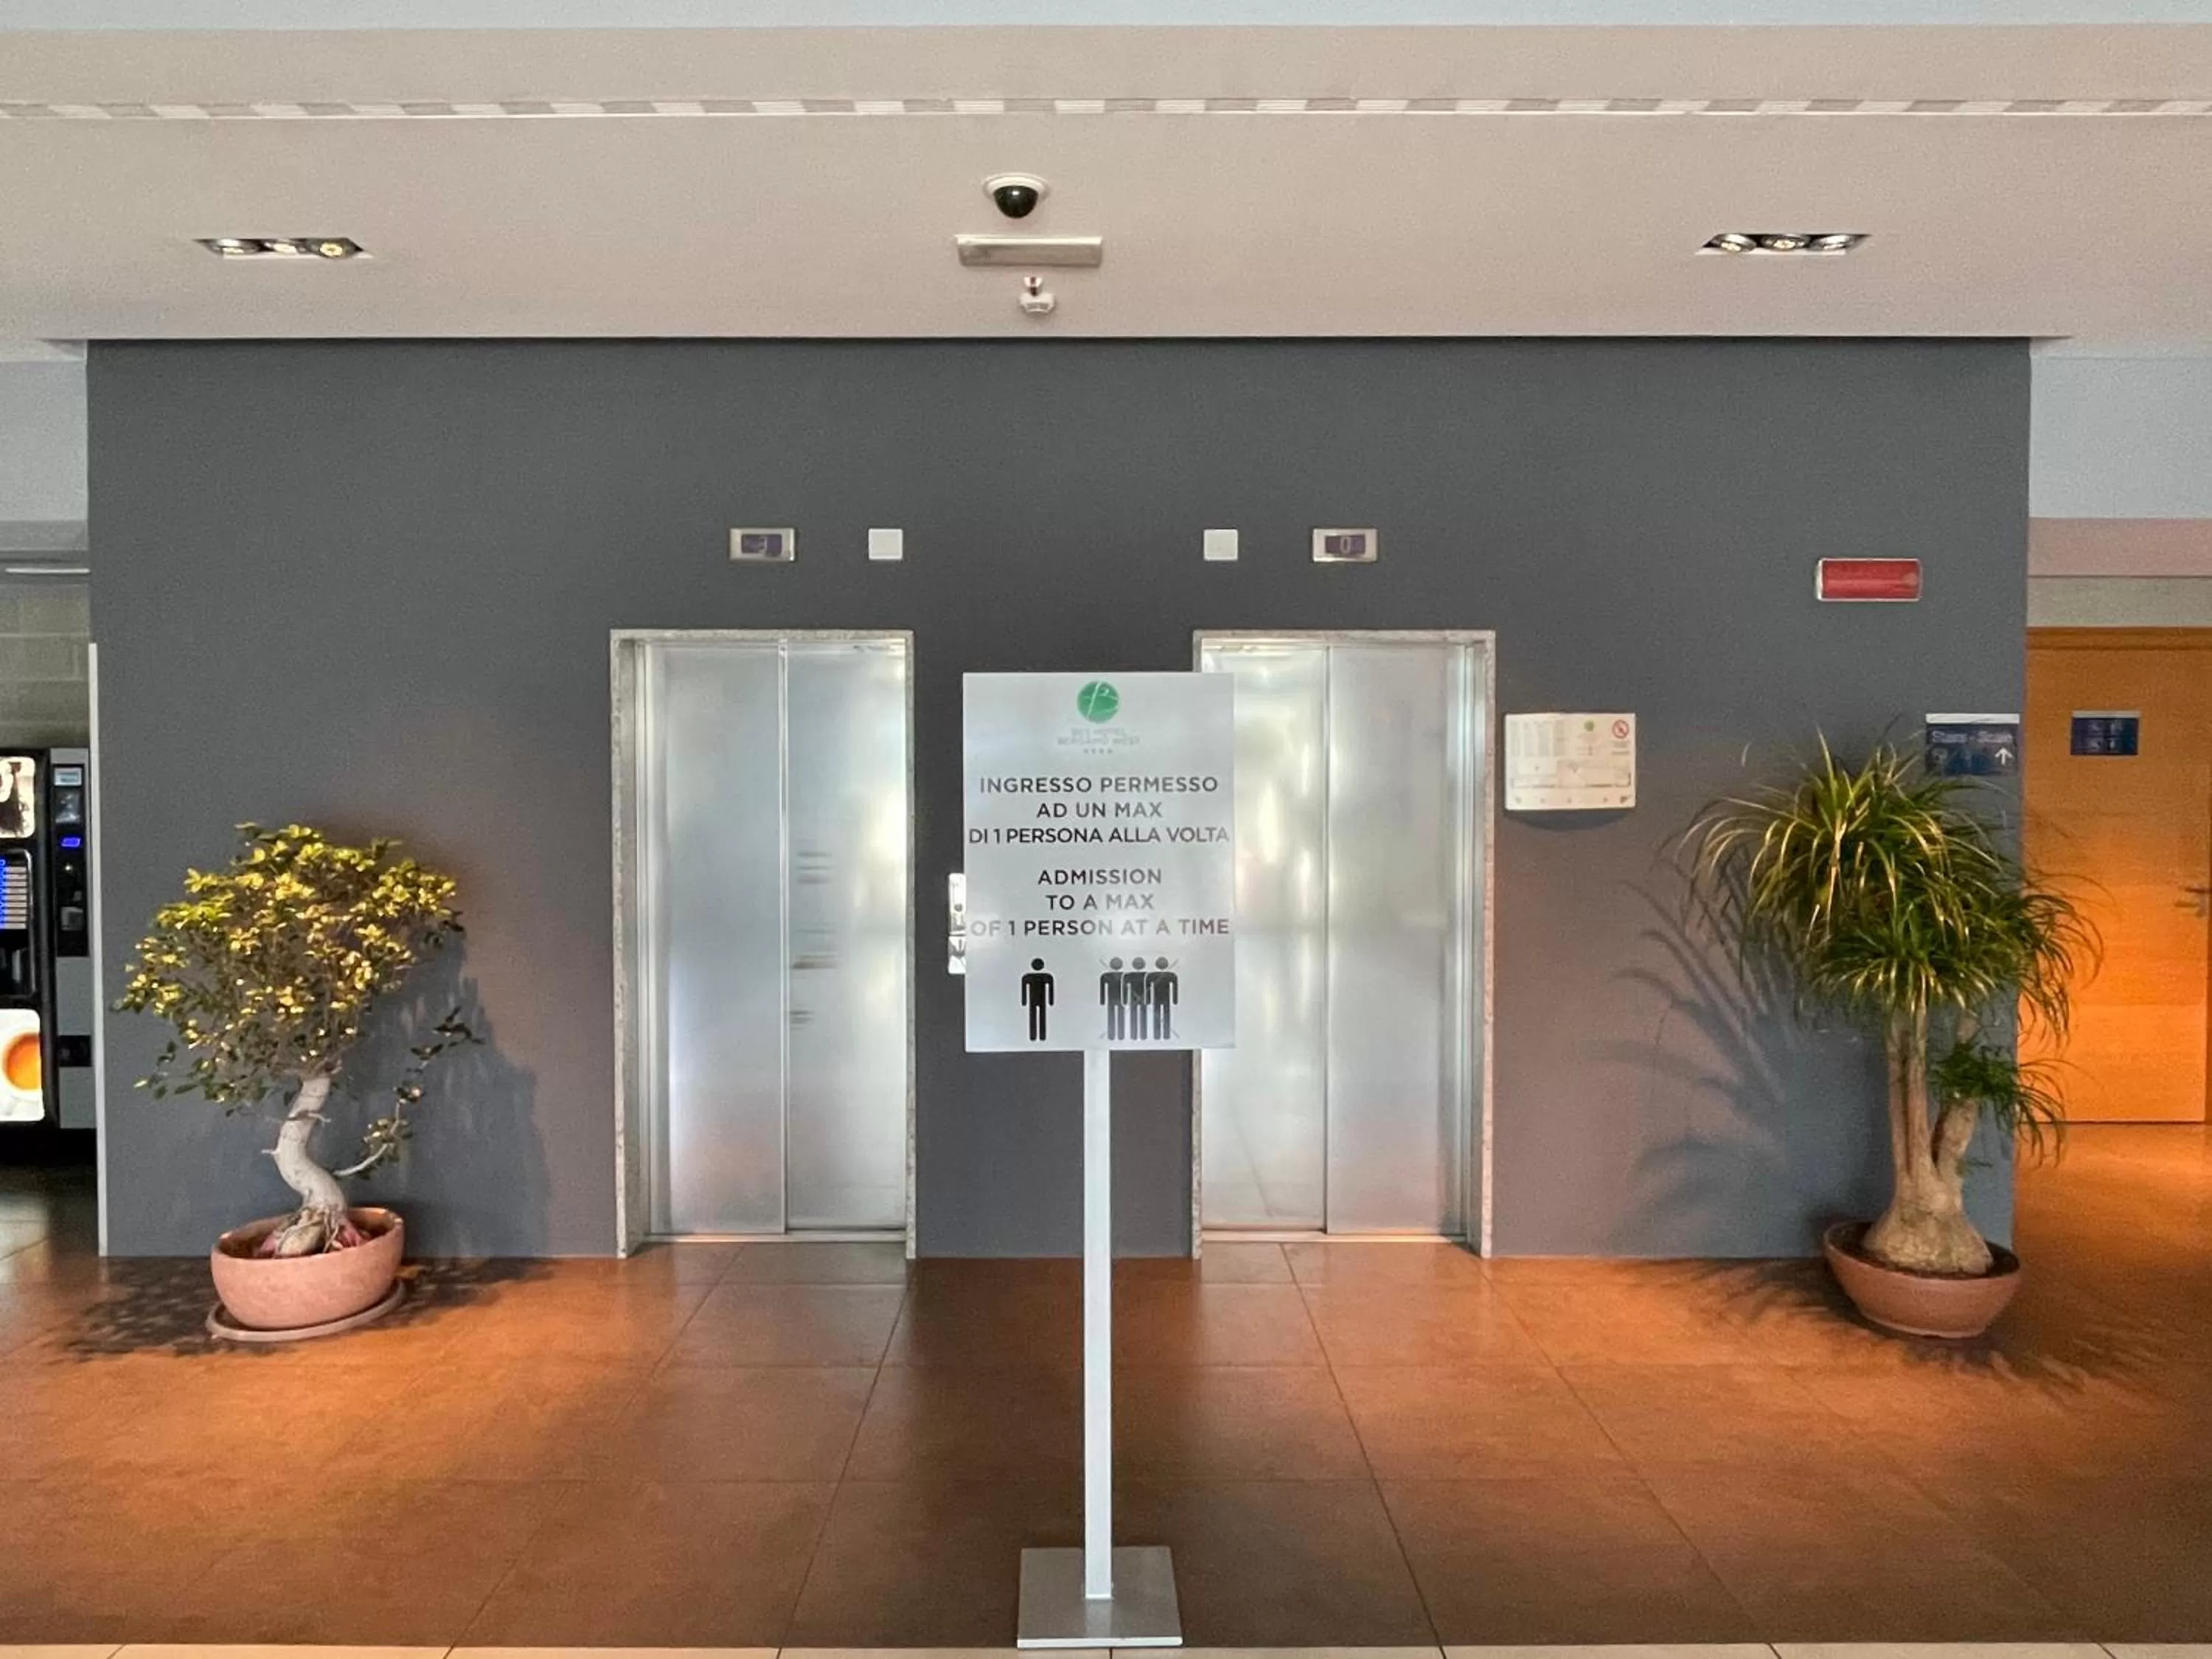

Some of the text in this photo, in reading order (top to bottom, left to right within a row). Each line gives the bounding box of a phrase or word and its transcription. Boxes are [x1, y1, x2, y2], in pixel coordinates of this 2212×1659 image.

[980, 776, 1219, 793] INGRESSO PERMESSO
[1036, 801, 1163, 818] AD UN MAX
[969, 827, 1229, 844] DI 1 PERSONA ALLA VOLTA
[1037, 869, 1162, 885] ADMISSION
[1045, 894, 1155, 911] TO A MAX
[970, 919, 1230, 936] OF 1 PERSON AT A TIME
